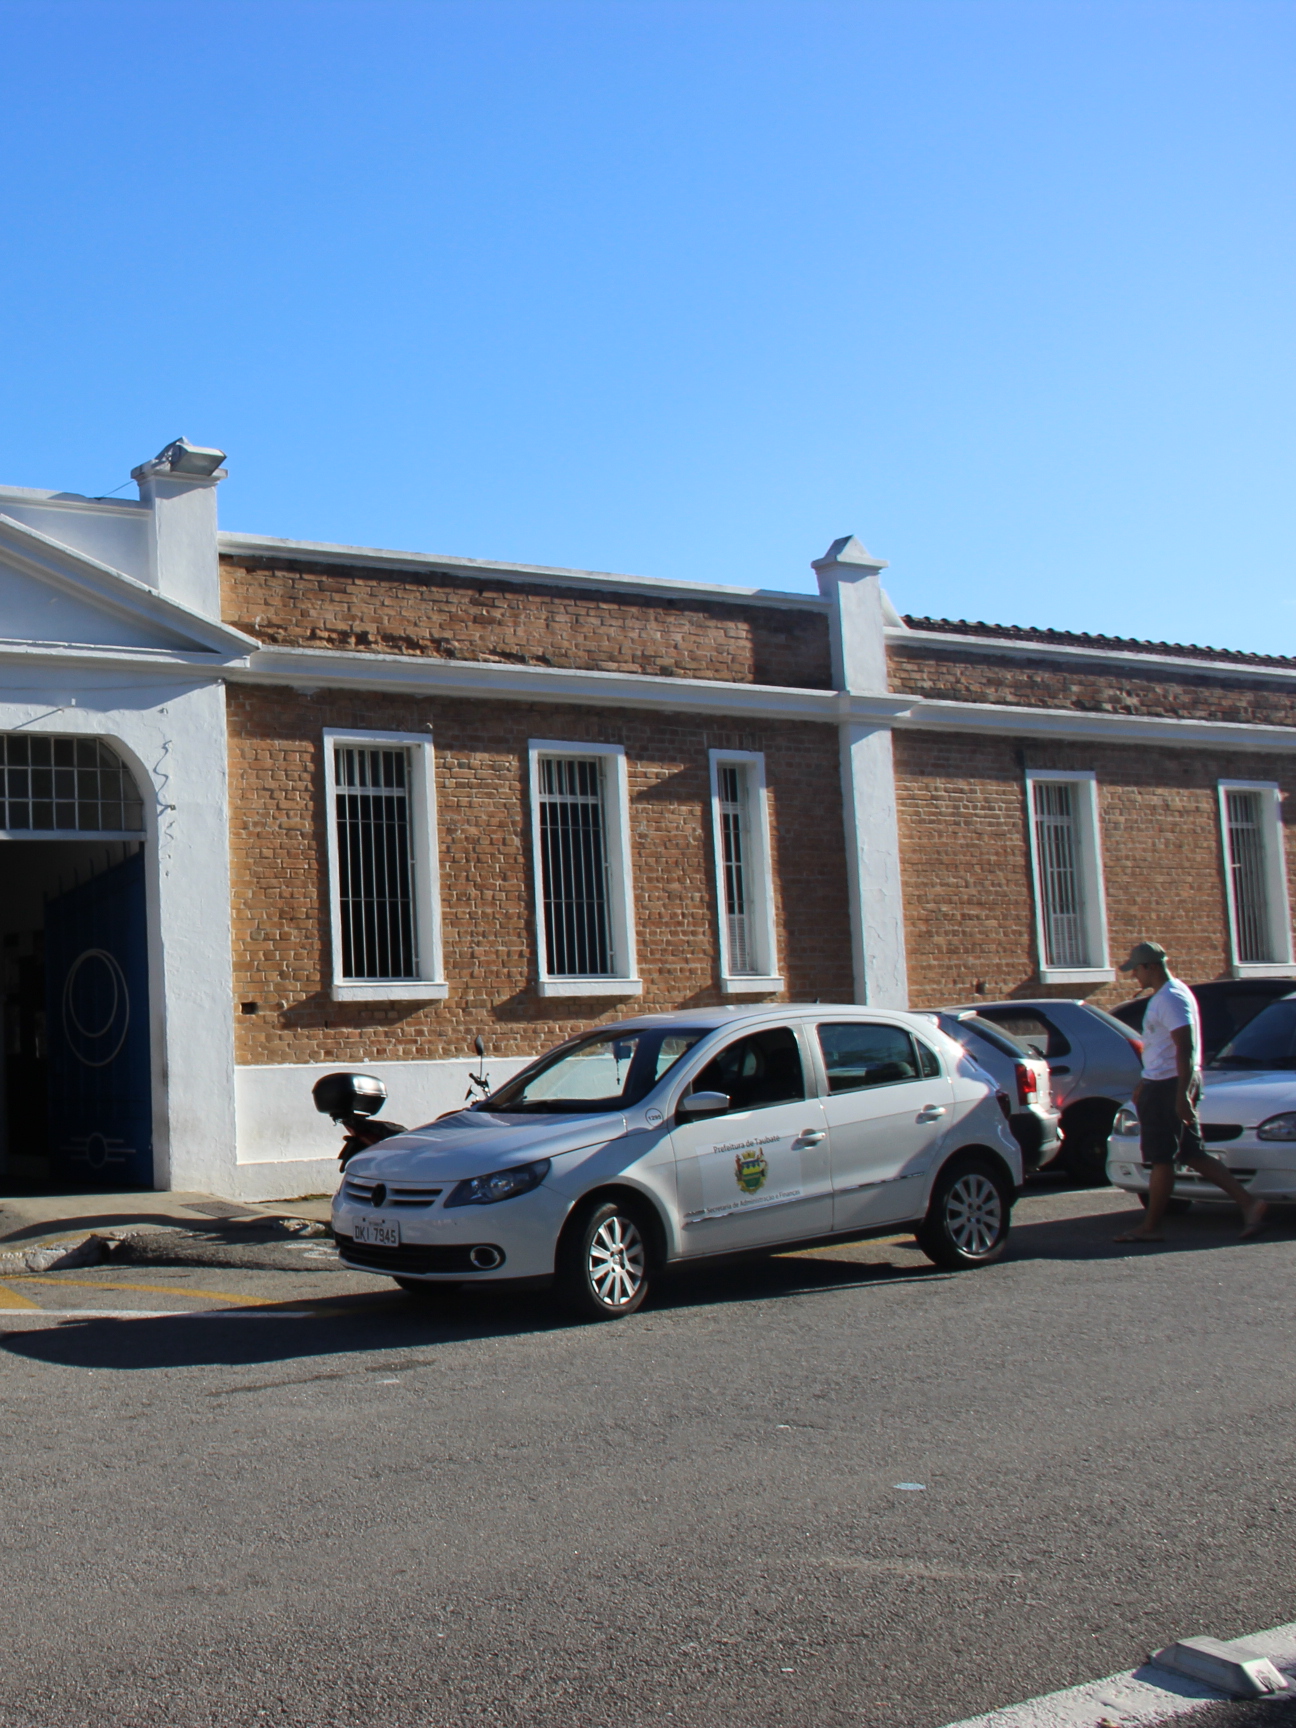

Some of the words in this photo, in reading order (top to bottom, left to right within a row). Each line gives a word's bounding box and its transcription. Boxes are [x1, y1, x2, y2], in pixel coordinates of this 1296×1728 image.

[713, 1143, 745, 1154] Prefeitura
[745, 1139, 754, 1148] de
[706, 1203, 732, 1214] Secretaria
[732, 1200, 740, 1208] de
